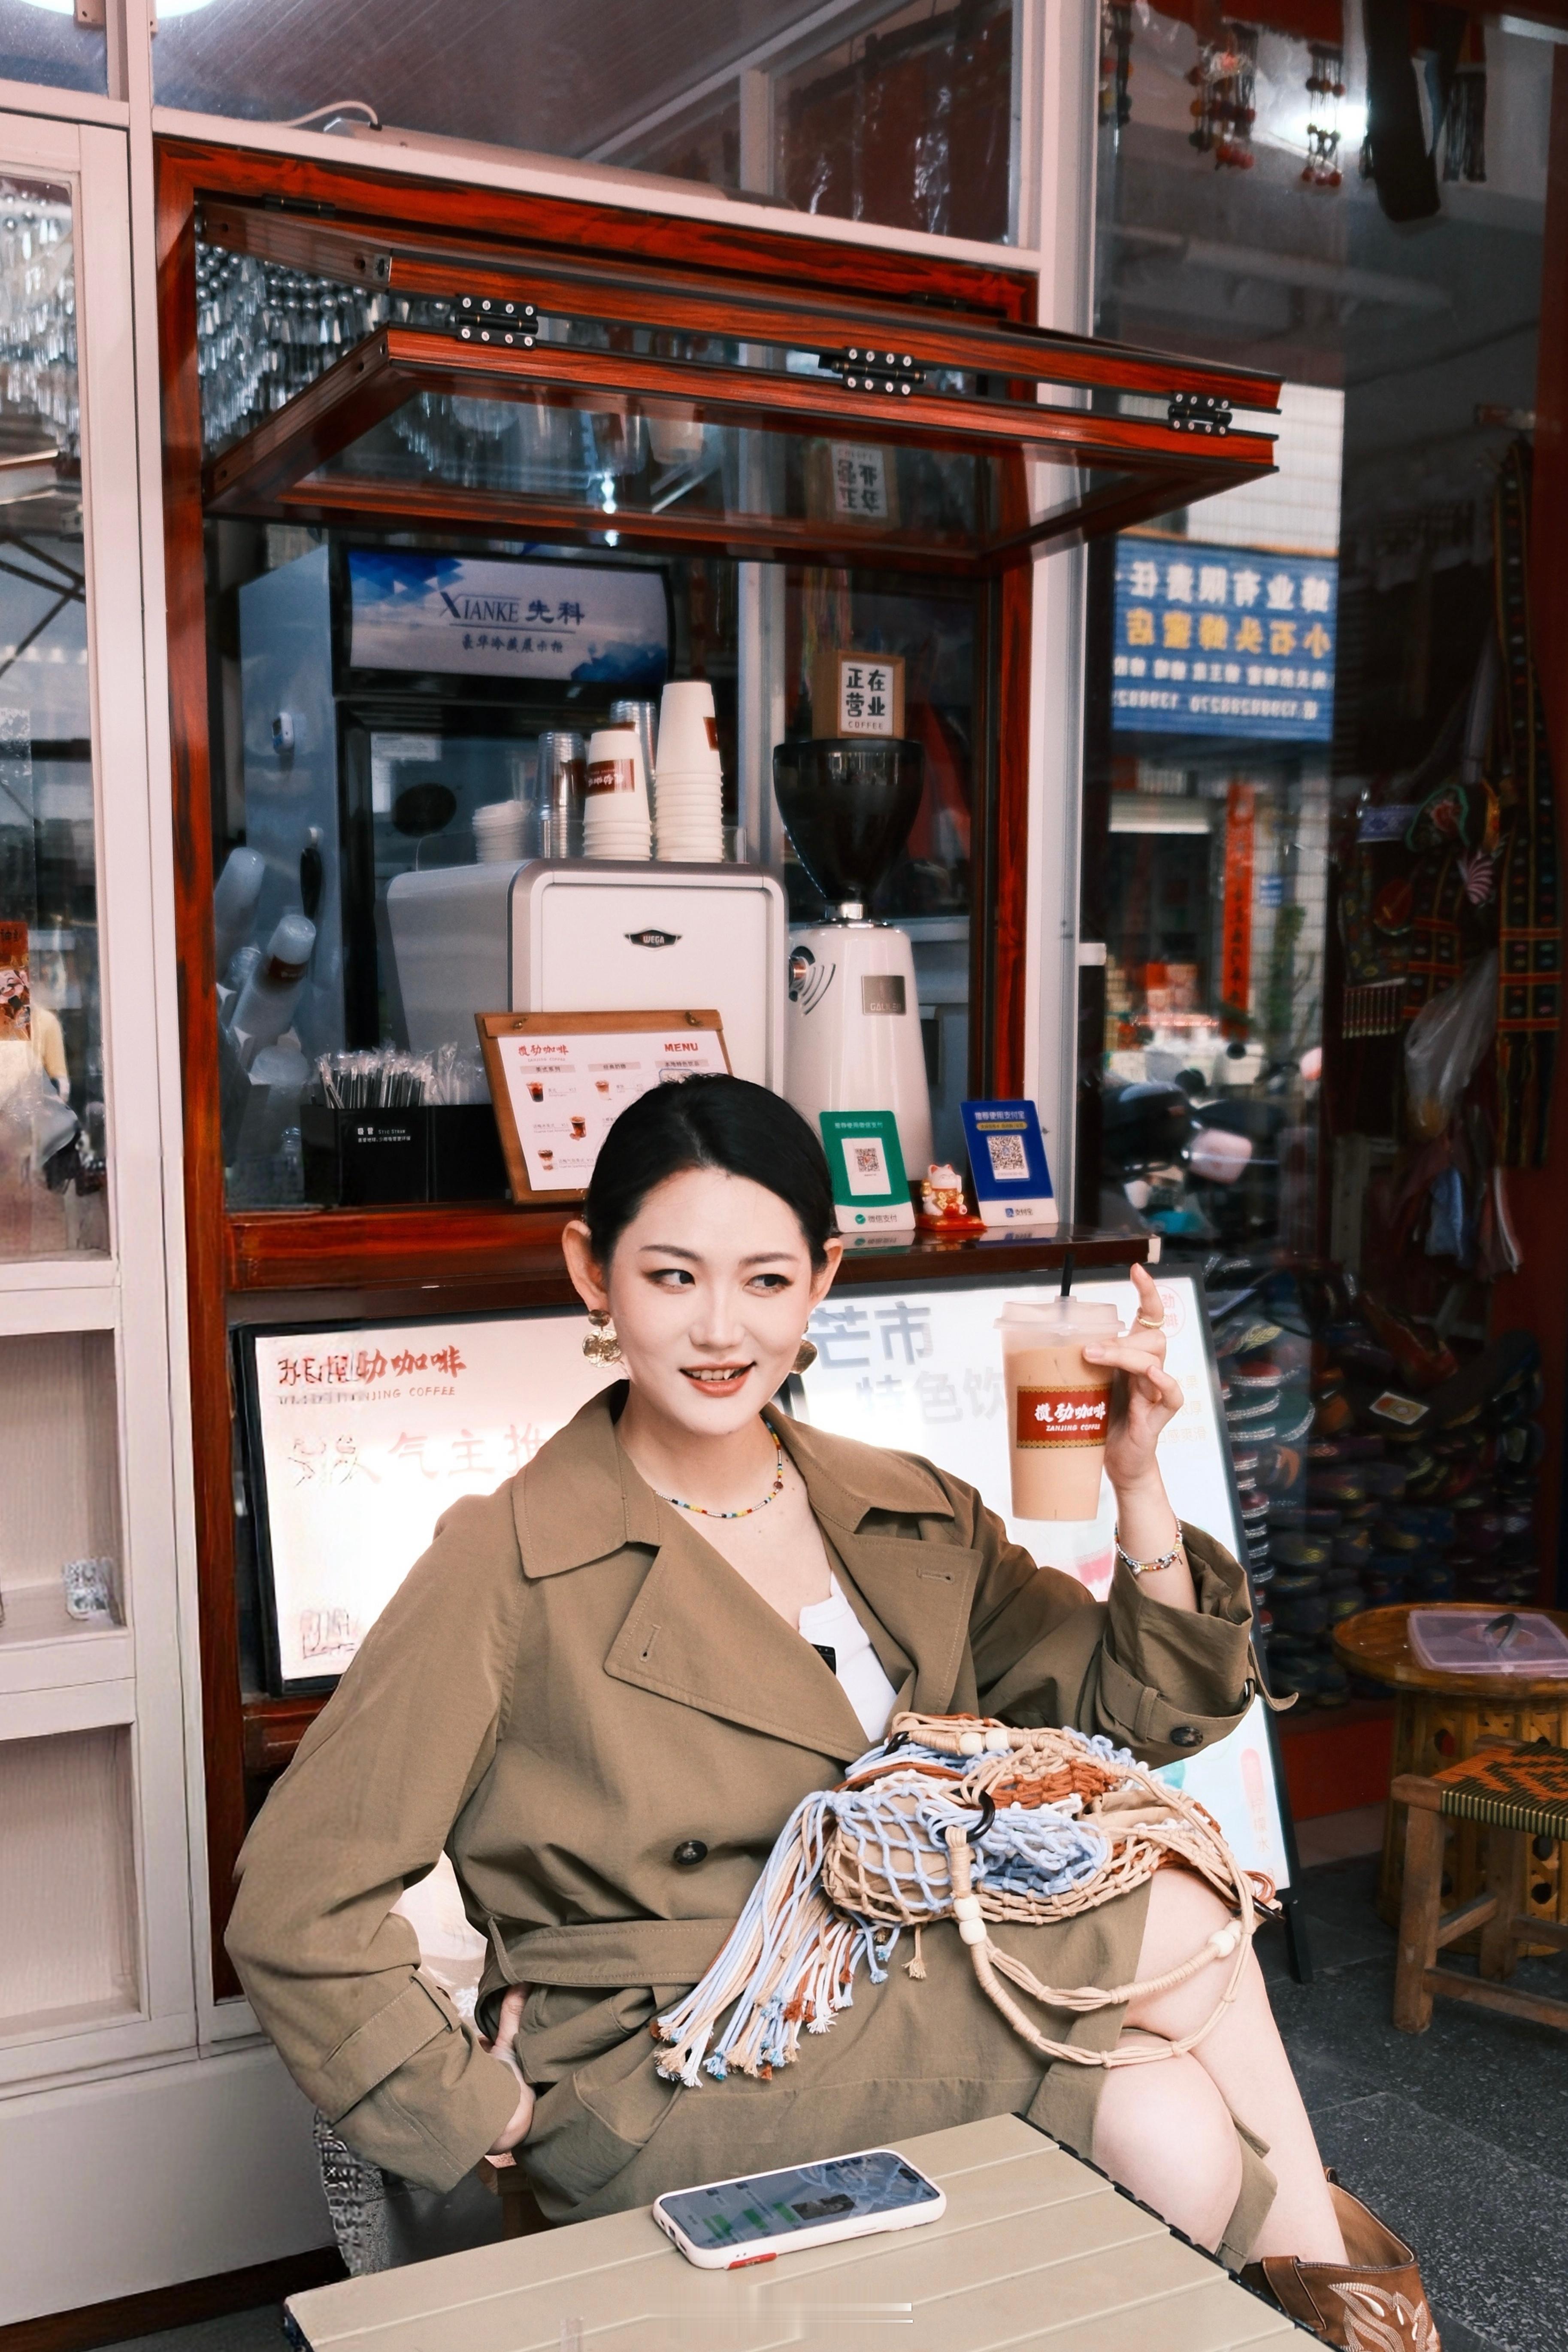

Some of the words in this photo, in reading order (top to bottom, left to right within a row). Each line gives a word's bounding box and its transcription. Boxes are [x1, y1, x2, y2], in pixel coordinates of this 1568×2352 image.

[439, 591, 521, 623] XIANKE
[526, 599, 586, 625] 先科
[846, 667, 886, 692] 正在
[845, 691, 886, 717] 营业
[848, 721, 884, 730] COFFEE
[664, 1043, 699, 1052] MENU
[868, 1215, 897, 1224] 微信支付
[409, 1386, 456, 1398] COFFEE
